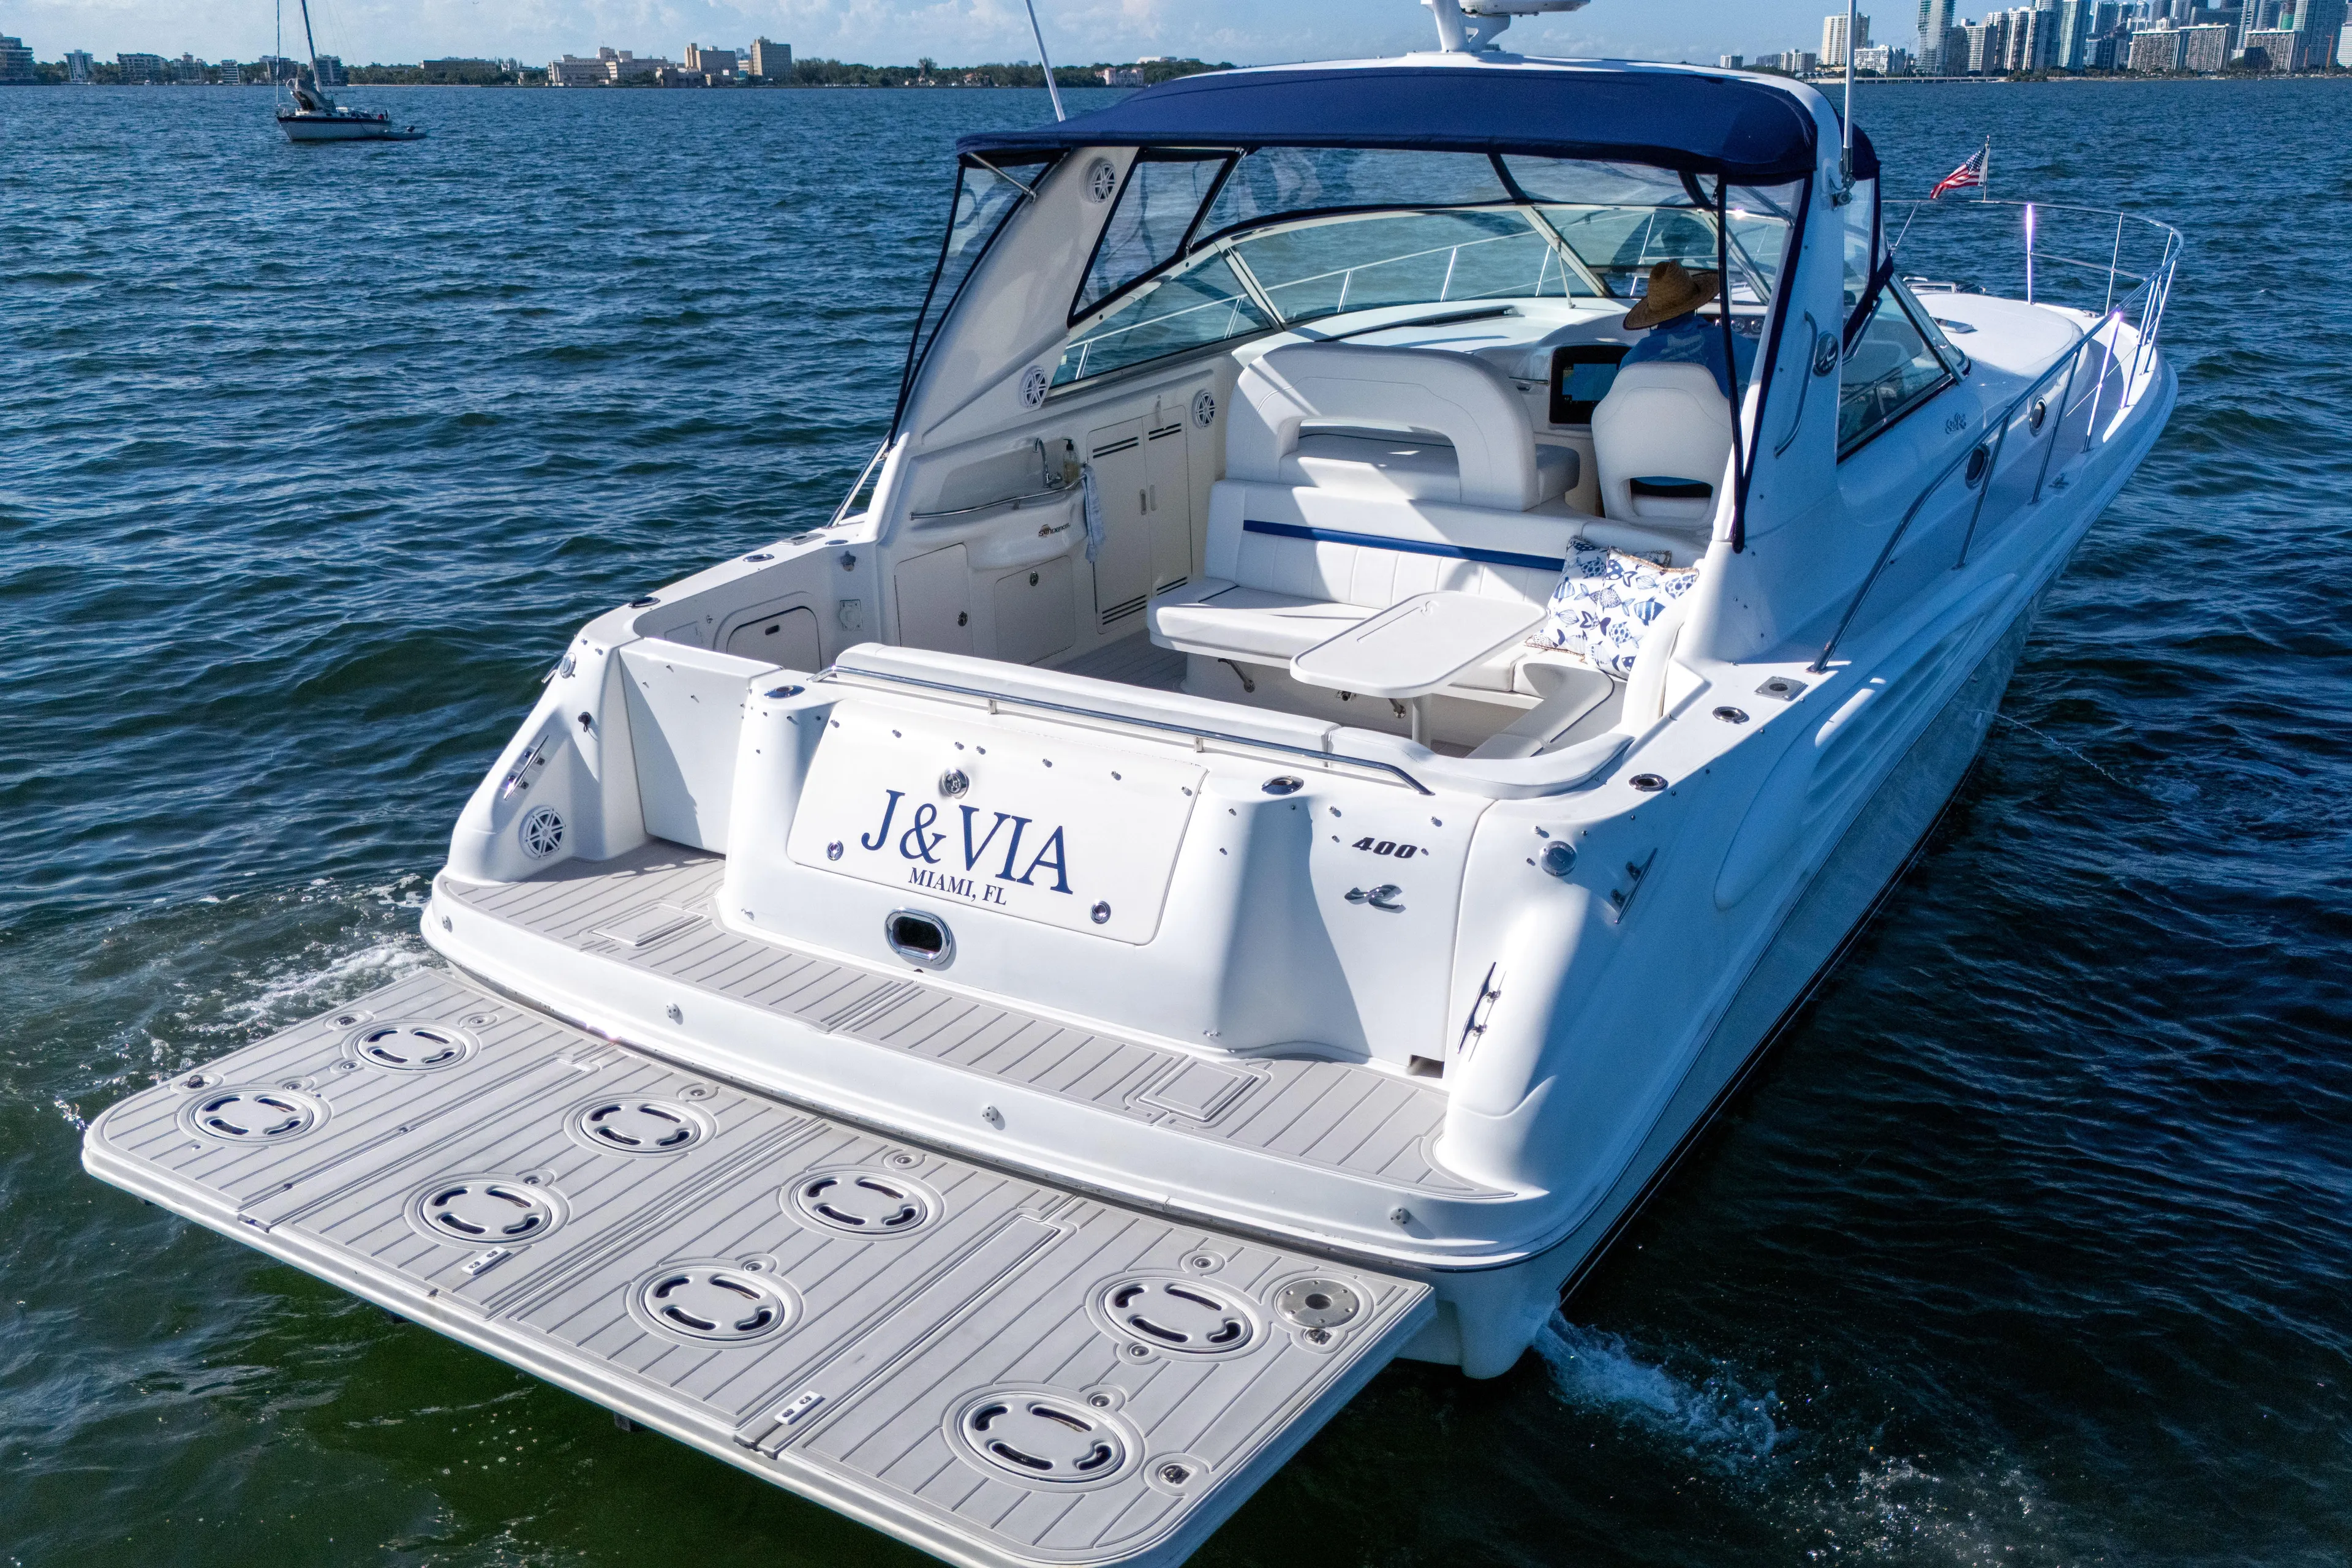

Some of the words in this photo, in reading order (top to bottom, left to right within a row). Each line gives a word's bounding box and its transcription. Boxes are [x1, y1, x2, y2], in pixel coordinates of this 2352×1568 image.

[861, 789, 1073, 895] J&VIA
[1352, 837, 1417, 859] 400
[908, 867, 976, 902] MIAMI,
[982, 884, 1007, 905] FL
